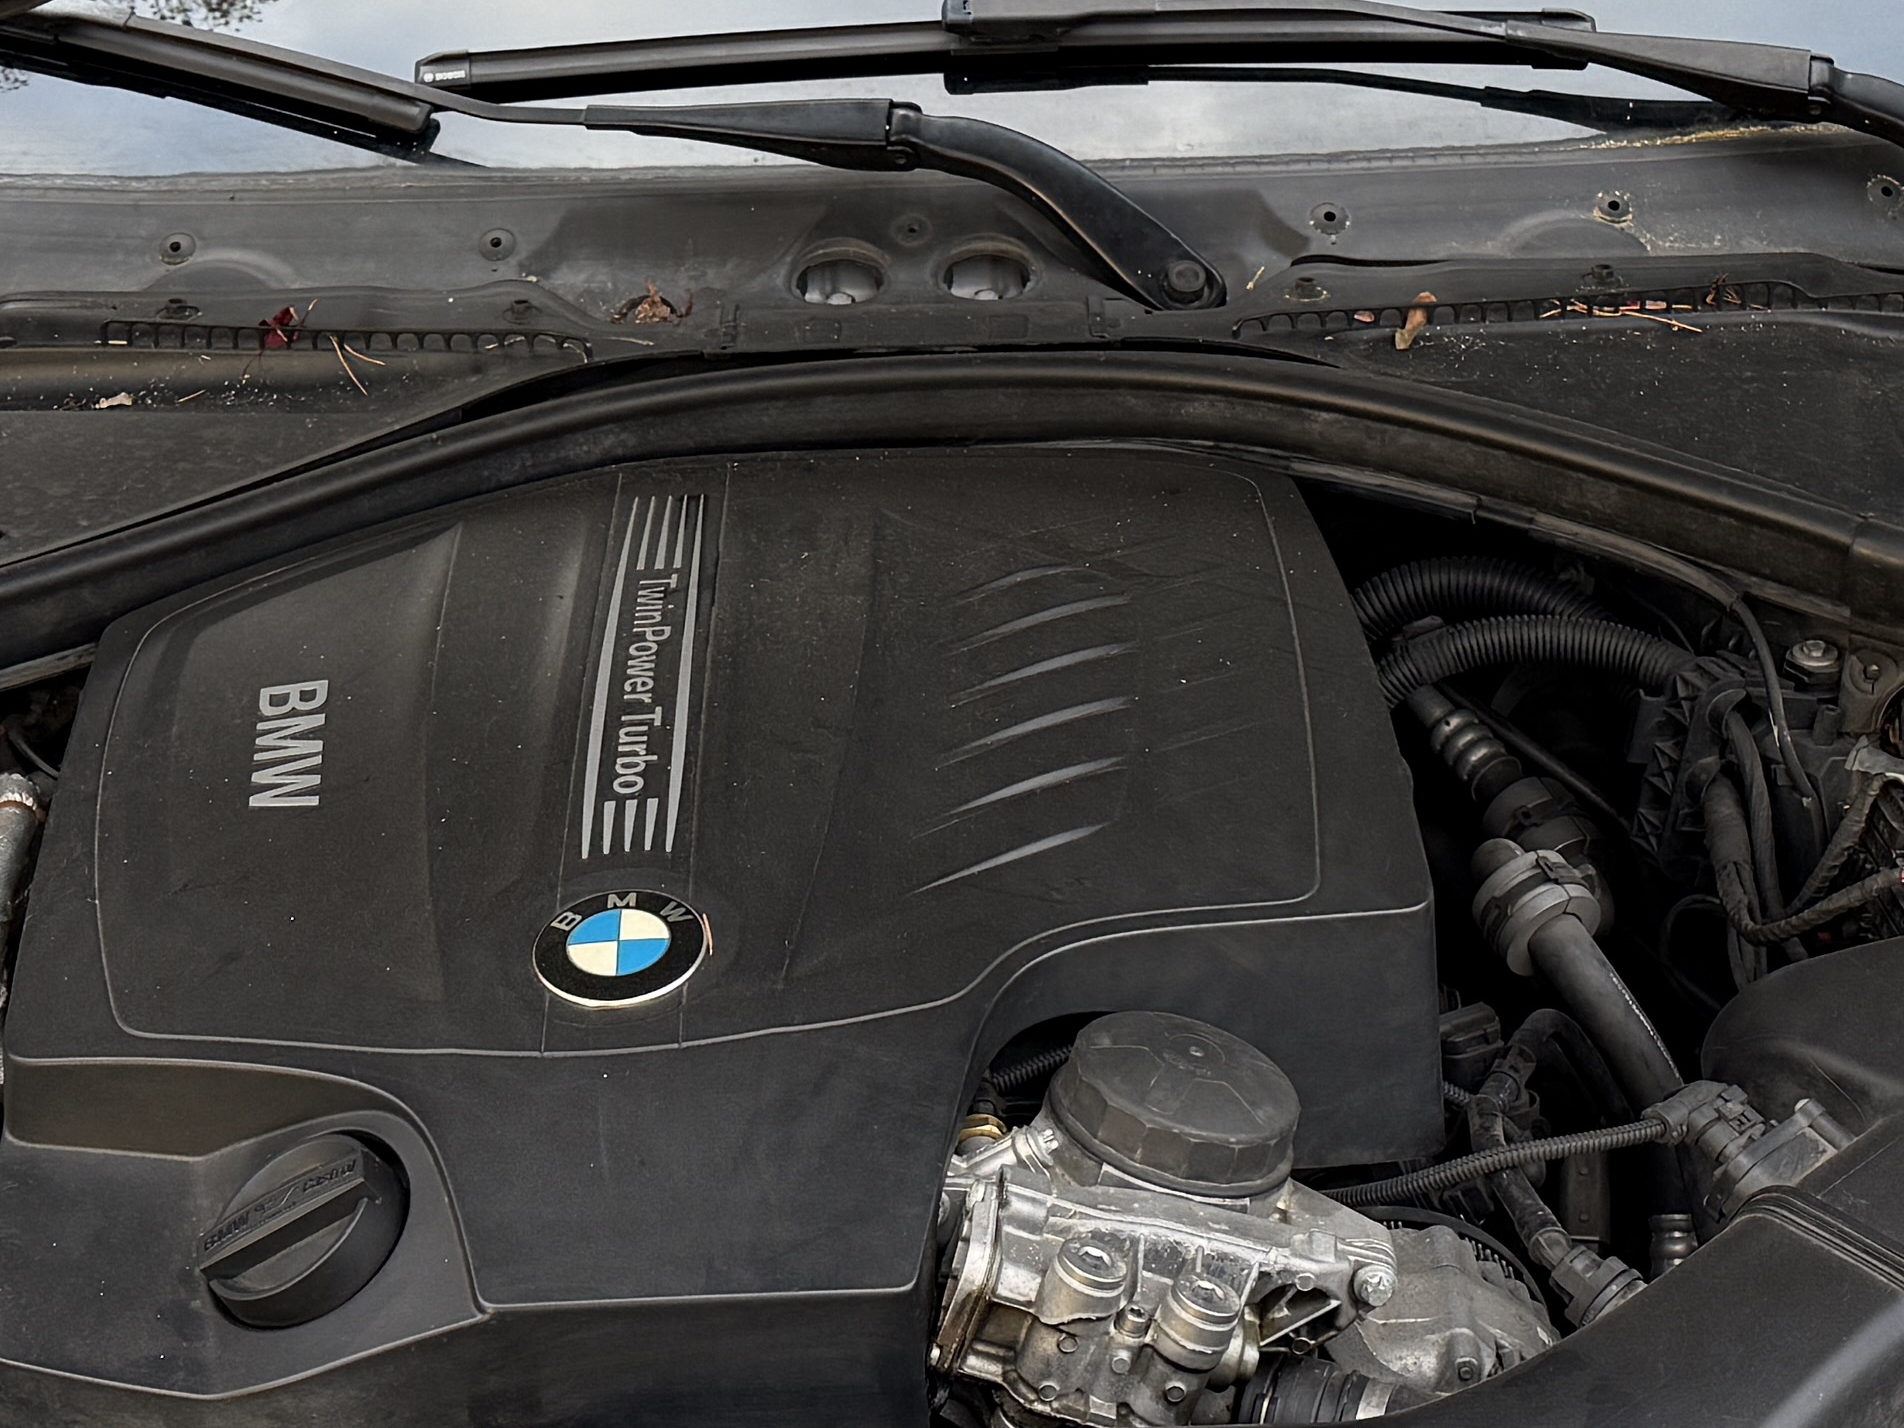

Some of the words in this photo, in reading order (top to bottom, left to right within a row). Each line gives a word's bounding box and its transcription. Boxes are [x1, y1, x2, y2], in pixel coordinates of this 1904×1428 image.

[623, 573, 678, 703] TwinPower
[248, 679, 329, 807] BMW
[612, 706, 663, 795] Turbo
[550, 891, 695, 932] BMW
